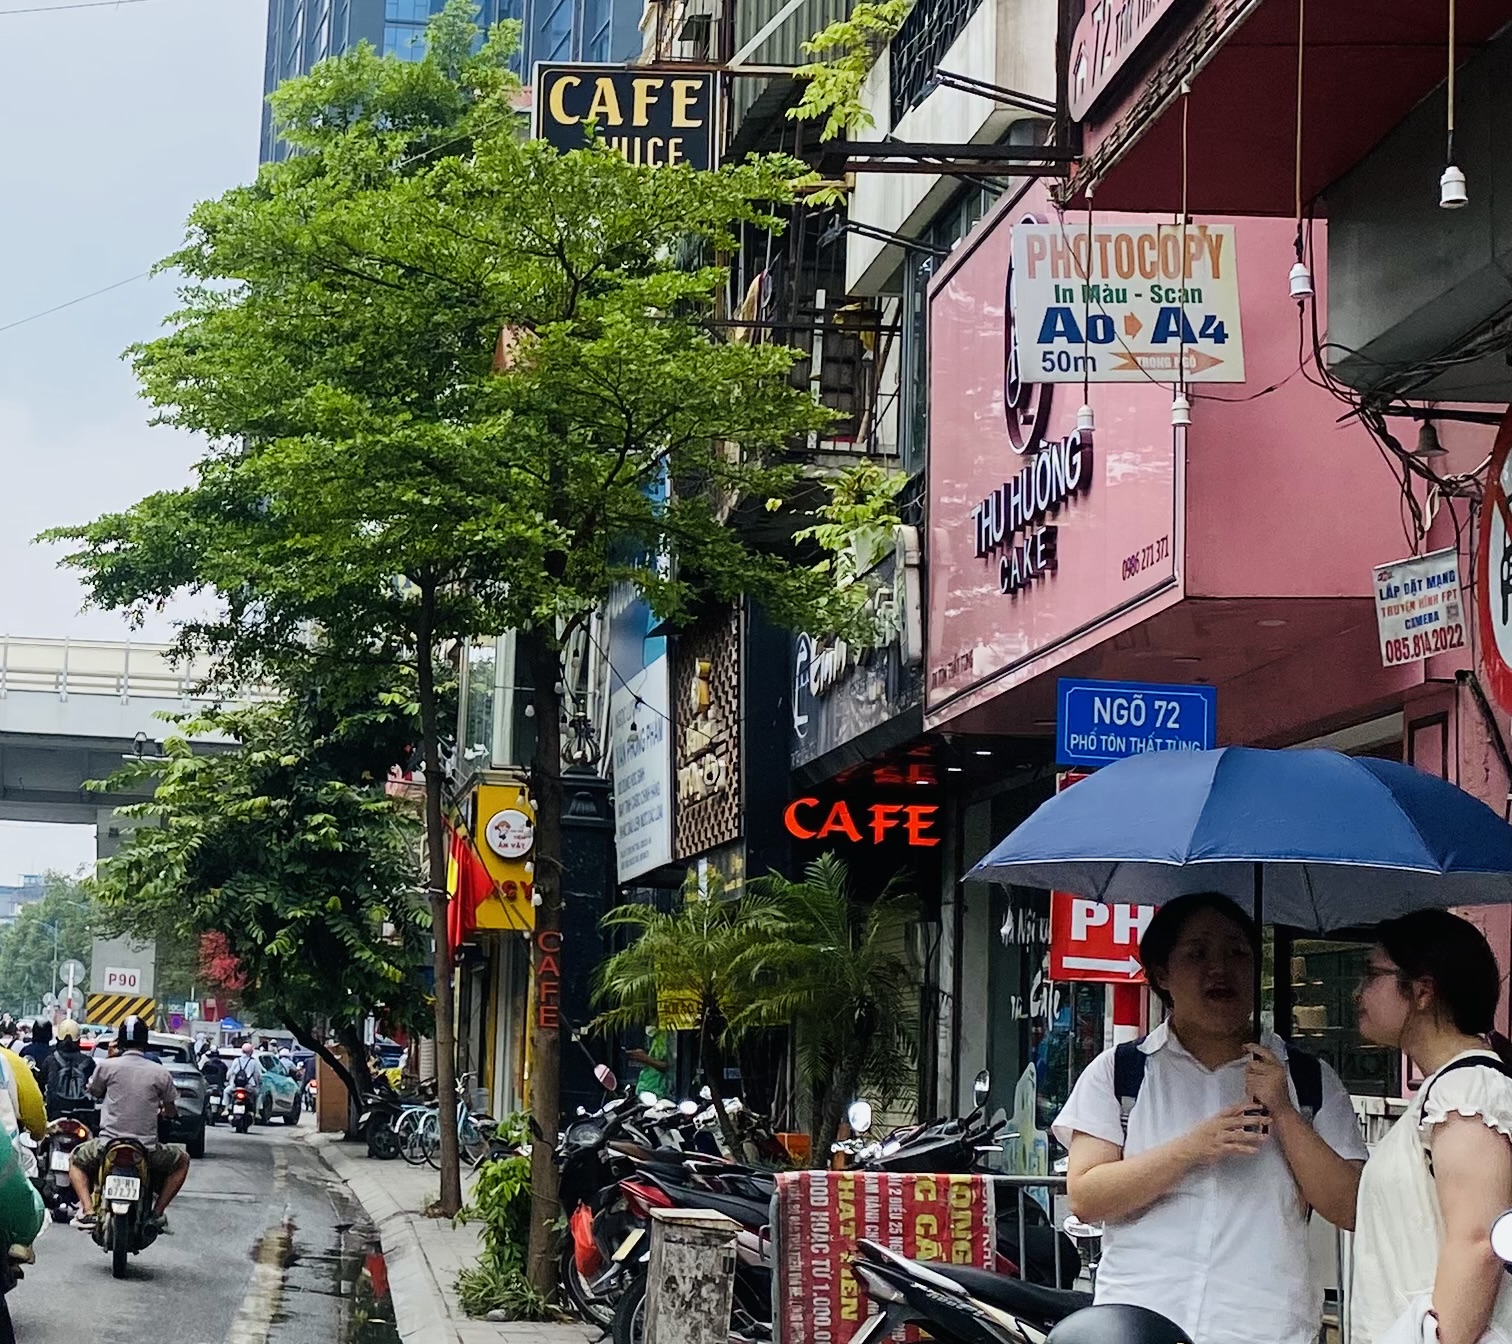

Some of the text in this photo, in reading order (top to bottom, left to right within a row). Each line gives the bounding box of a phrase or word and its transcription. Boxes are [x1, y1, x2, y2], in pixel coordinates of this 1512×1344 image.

[549, 75, 704, 128] CAFE
[597, 135, 683, 169] UICE
[1026, 233, 1224, 280] PHOTOCOPY
[1054, 284, 1074, 304] In
[1081, 283, 1128, 304] Màu
[1149, 284, 1203, 304] Scan
[1149, 306, 1229, 345] A4
[1041, 350, 1098, 373] 50m
[971, 483, 1005, 558] THU
[998, 527, 1047, 594] CAKE
[1093, 693, 1181, 729] NGÕ 72
[1070, 726, 1098, 751] PHỐ
[1100, 732, 1126, 753] TÔN
[784, 797, 941, 847] CAFE
[108, 973, 137, 988] P90
[538, 931, 561, 1028] CAFE
[949, 1174, 977, 1264] ÔNG
